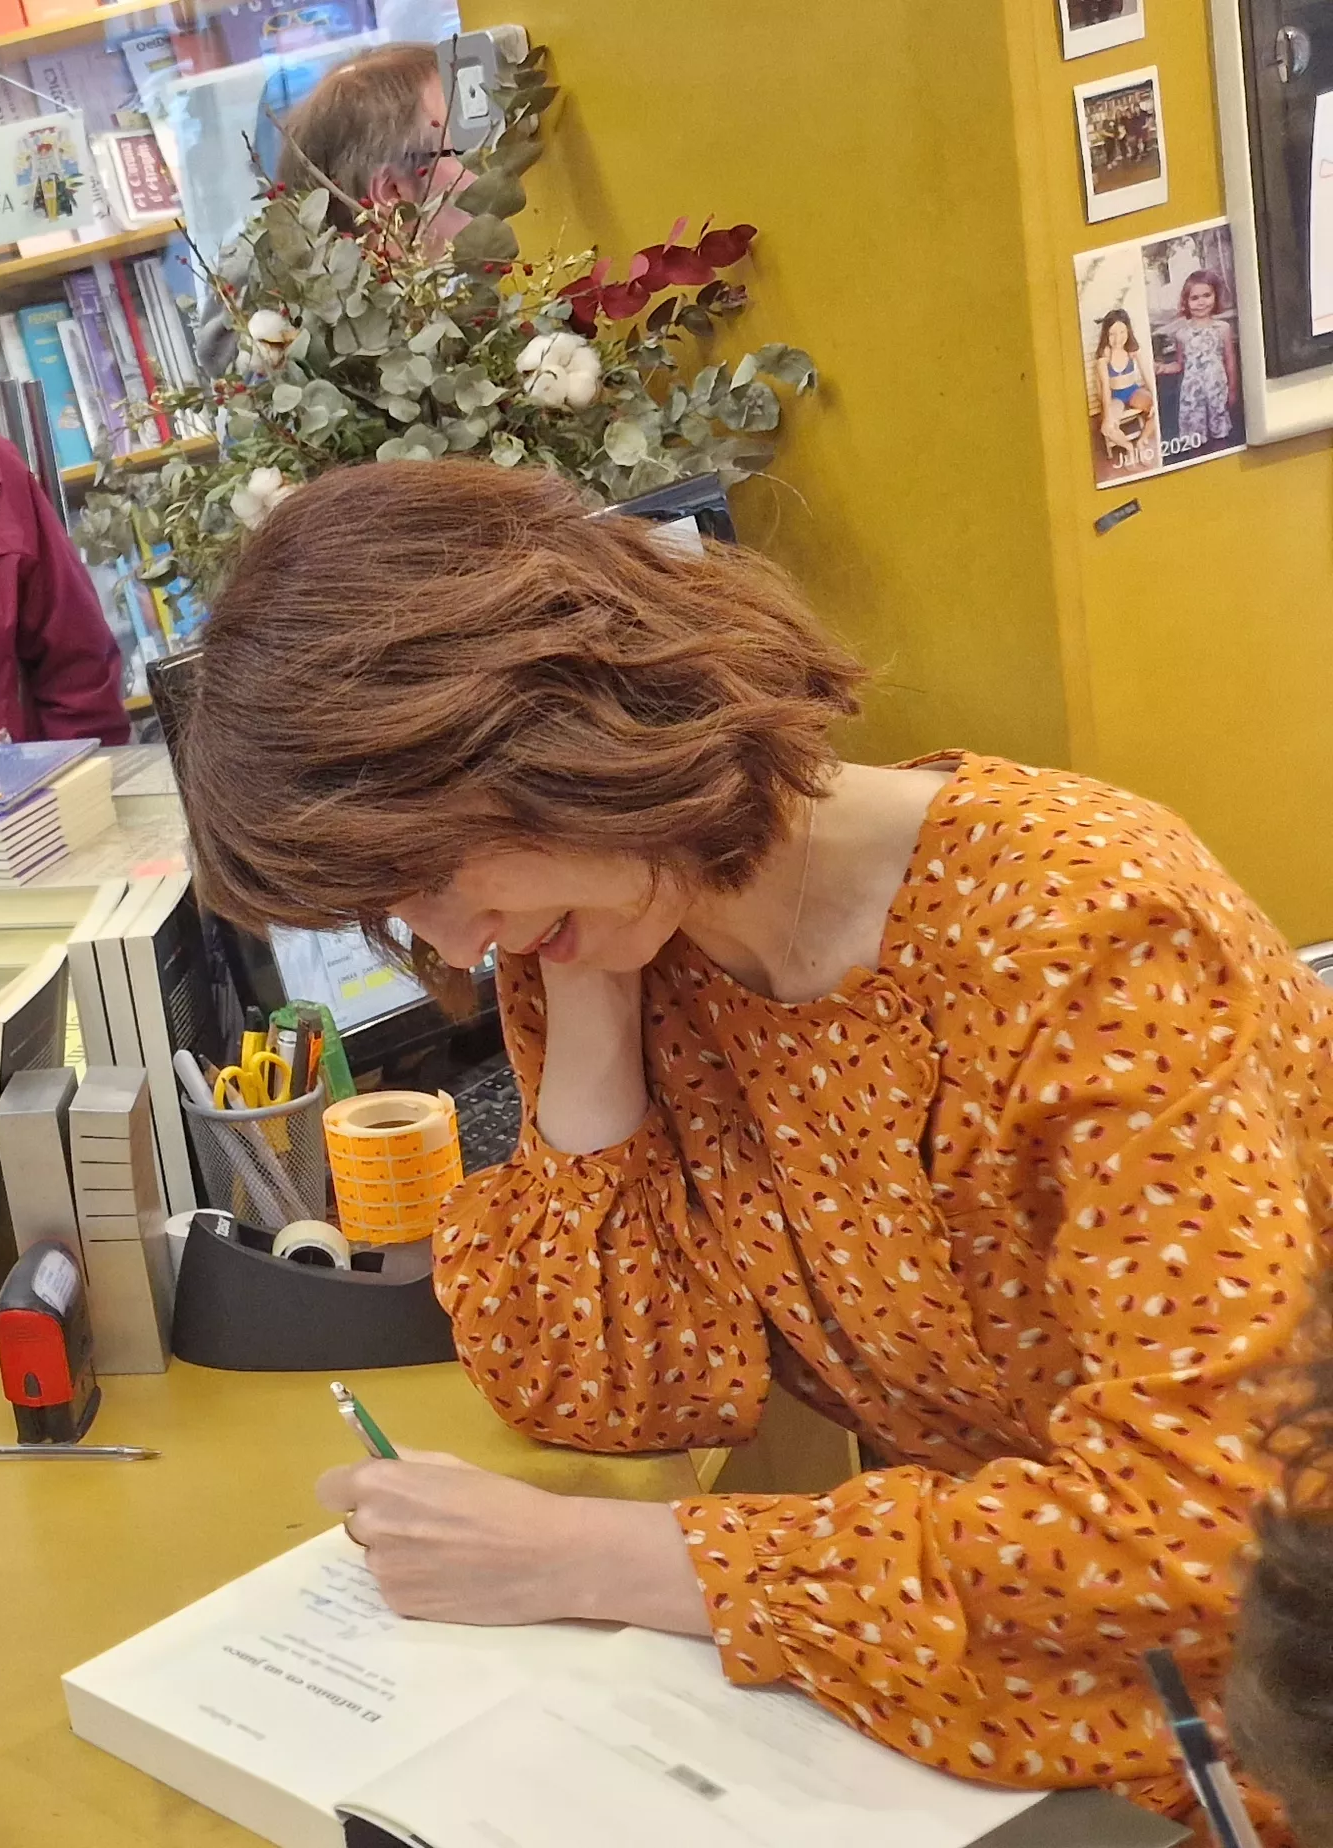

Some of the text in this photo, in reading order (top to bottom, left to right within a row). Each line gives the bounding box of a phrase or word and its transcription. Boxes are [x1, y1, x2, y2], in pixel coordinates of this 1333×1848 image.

[1112, 432, 1202, 469] Julio 2020
[303, 1681, 363, 1717] infinito
